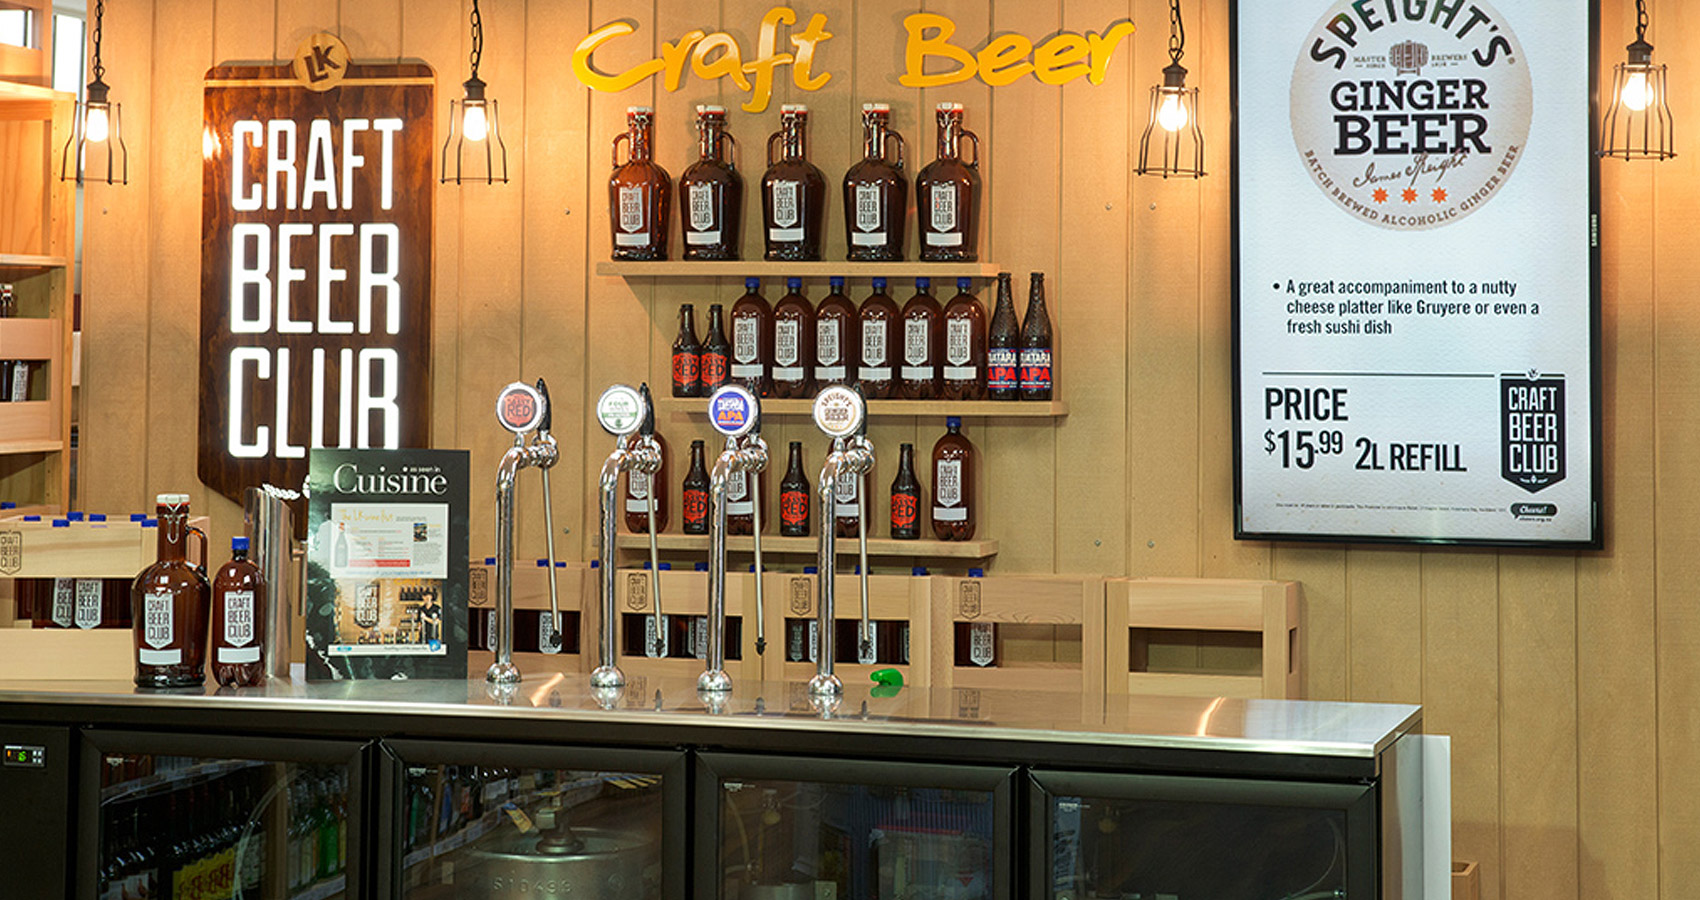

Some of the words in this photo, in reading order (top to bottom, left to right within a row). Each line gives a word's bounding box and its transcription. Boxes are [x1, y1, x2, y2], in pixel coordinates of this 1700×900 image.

[1310, 0, 1513, 70] SPEIGHT'S
[304, 45, 341, 83] LK
[572, 6, 833, 112] Craft
[899, 13, 1136, 87] Beer
[1330, 79, 1490, 112] GINGER
[1333, 113, 1492, 155] BEER
[232, 118, 404, 211] CRAFT
[1304, 150, 1334, 189] BATCH
[1331, 187, 1379, 220] BREWED
[1381, 207, 1458, 226] ALCOHOLIC
[1460, 175, 1501, 212] GINGER
[1497, 143, 1520, 176] BEER
[230, 223, 400, 334] BEER
[1286, 280, 1296, 294] A
[1300, 282, 1334, 297] great
[1338, 280, 1447, 297] accompaniment
[1451, 281, 1465, 294] to
[1469, 284, 1478, 294] a
[1482, 281, 1516, 298] nutty
[1287, 300, 1335, 314] cheese
[1339, 300, 1386, 316] platter
[1388, 300, 1412, 314] like
[1416, 301, 1471, 318] Gruyere
[1475, 304, 1490, 314] or
[1494, 304, 1526, 314] even
[1531, 304, 1539, 314] a
[1287, 320, 1321, 334] fresh
[1326, 320, 1360, 334] sushi
[1364, 320, 1392, 334] dish
[988, 367, 1017, 381] APA
[1020, 367, 1050, 381] APA
[229, 347, 400, 458] CLUB
[508, 404, 530, 416] RED
[1264, 388, 1348, 421] PRICE
[1508, 386, 1558, 411] CRAFT
[718, 410, 744, 420] APA
[1509, 413, 1558, 442] BEER
[1264, 428, 1344, 469] $15.99
[1355, 438, 1384, 470] 2L
[1390, 444, 1468, 472] REFILL
[1509, 444, 1558, 474] CLUB
[334, 463, 447, 495] Cuisine
[783, 503, 806, 515] RED
[147, 600, 169, 611] CRAFT
[228, 598, 249, 608] CRAFT
[228, 610, 251, 623] BEER
[148, 612, 169, 624] BEER
[228, 625, 251, 637] CLUB
[148, 627, 169, 640] CLUB
